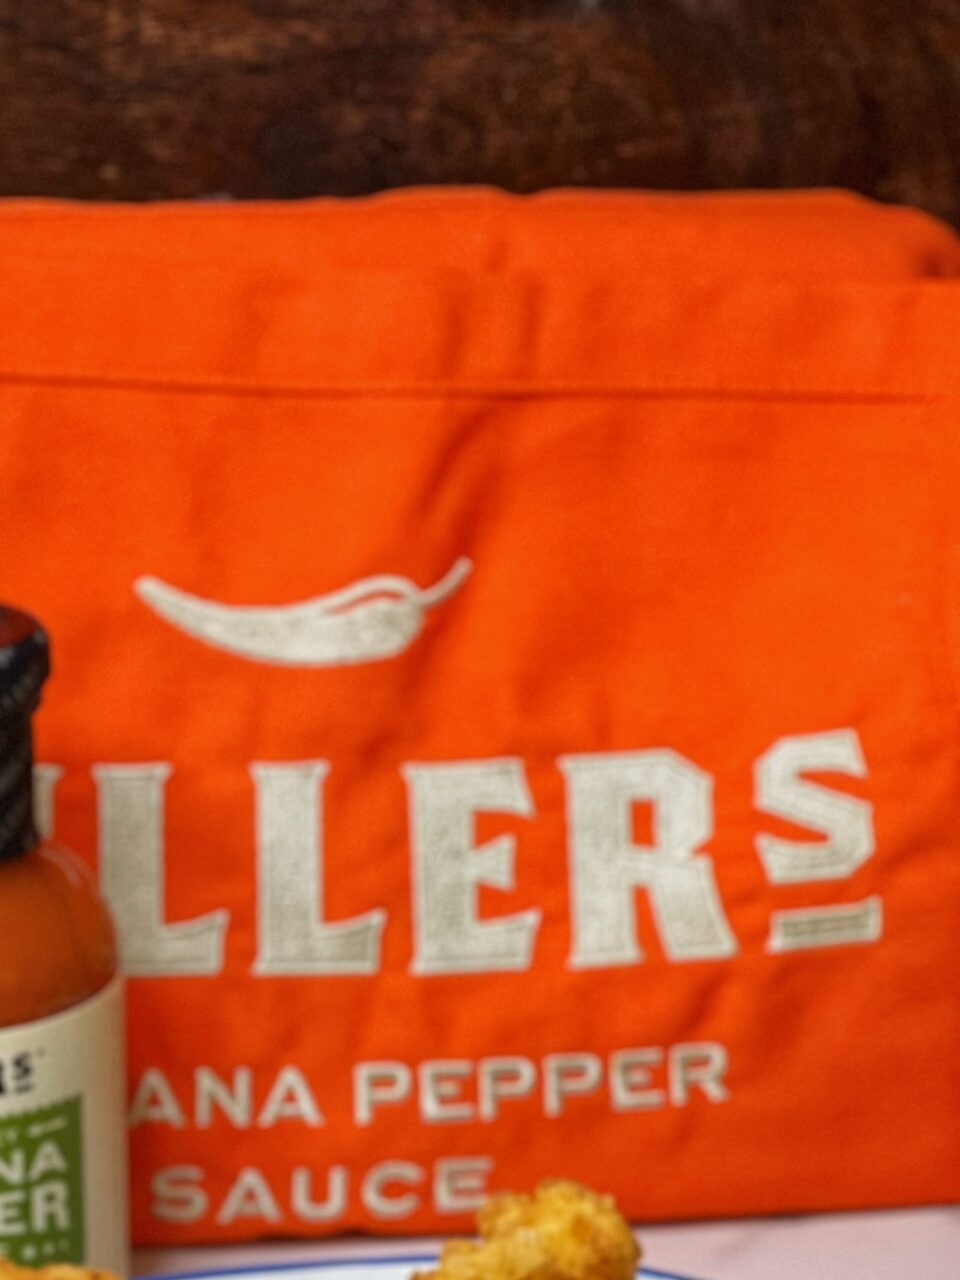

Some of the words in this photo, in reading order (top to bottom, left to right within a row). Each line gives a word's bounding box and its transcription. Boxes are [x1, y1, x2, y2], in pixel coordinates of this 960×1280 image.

[126, 1064, 325, 1130] ANA
[352, 1041, 729, 1128] PEPPER
[150, 1157, 493, 1226] SAUCE
